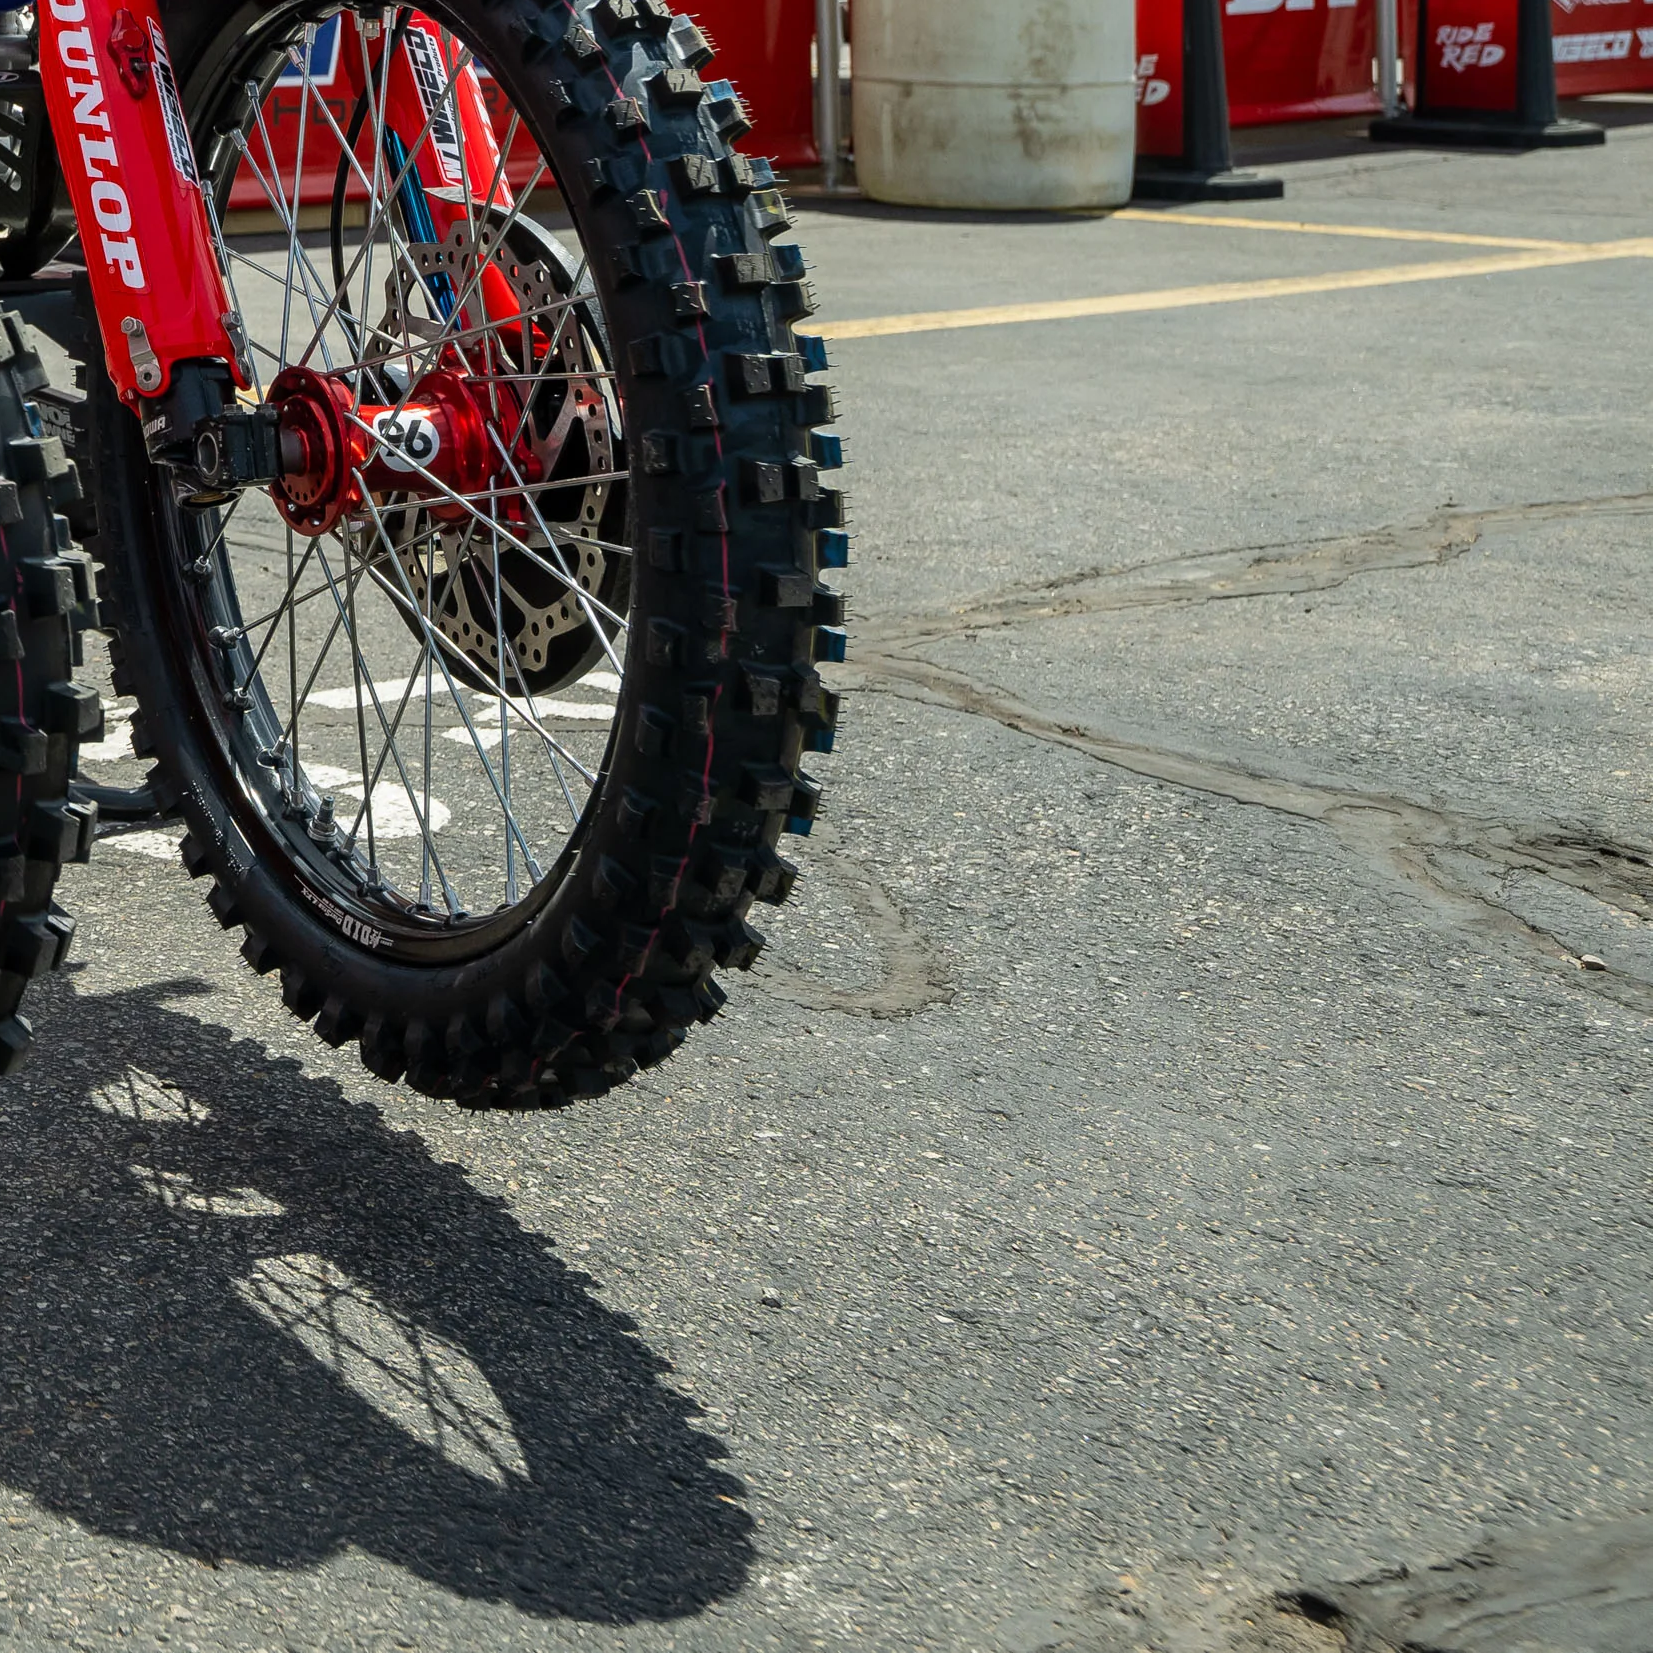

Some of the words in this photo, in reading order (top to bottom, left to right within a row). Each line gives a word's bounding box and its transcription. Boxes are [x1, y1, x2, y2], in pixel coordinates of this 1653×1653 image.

[1436, 22, 1495, 46] RIDE
[1440, 44, 1506, 73] RED
[1134, 80, 1170, 105] ED
[144, 415, 166, 438] OWA
